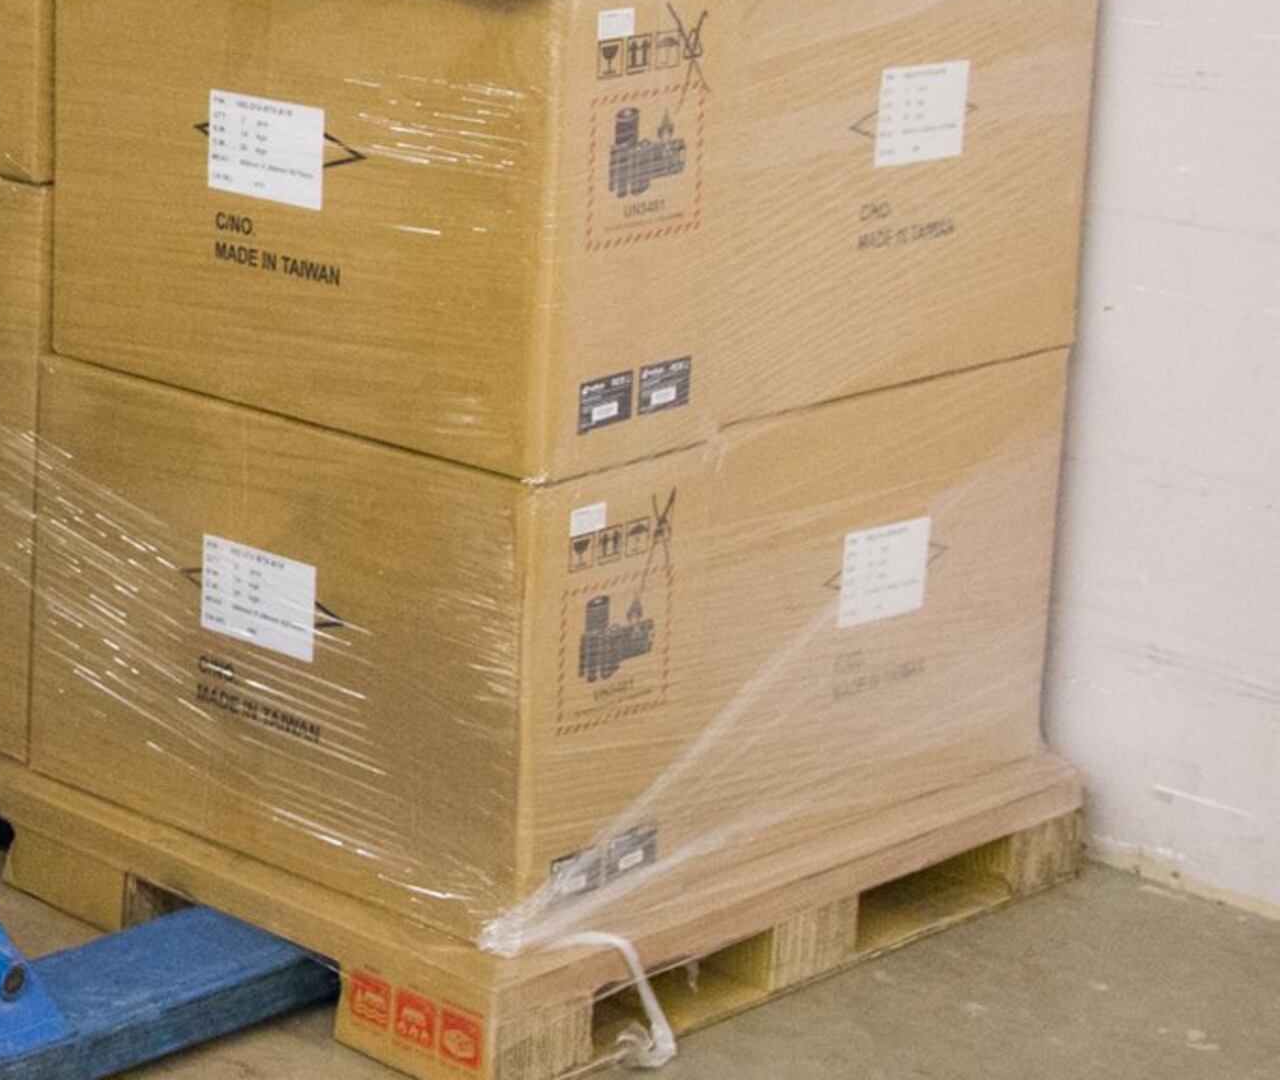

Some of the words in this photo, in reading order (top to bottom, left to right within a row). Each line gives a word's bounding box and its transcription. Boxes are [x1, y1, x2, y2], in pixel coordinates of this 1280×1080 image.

[215, 241, 258, 266] MADE
[262, 251, 277, 271] IN
[281, 256, 342, 286] TAIWAN
[197, 683, 240, 713] MADE
[242, 699, 258, 721] IN
[261, 706, 321, 743] TAIWAN
